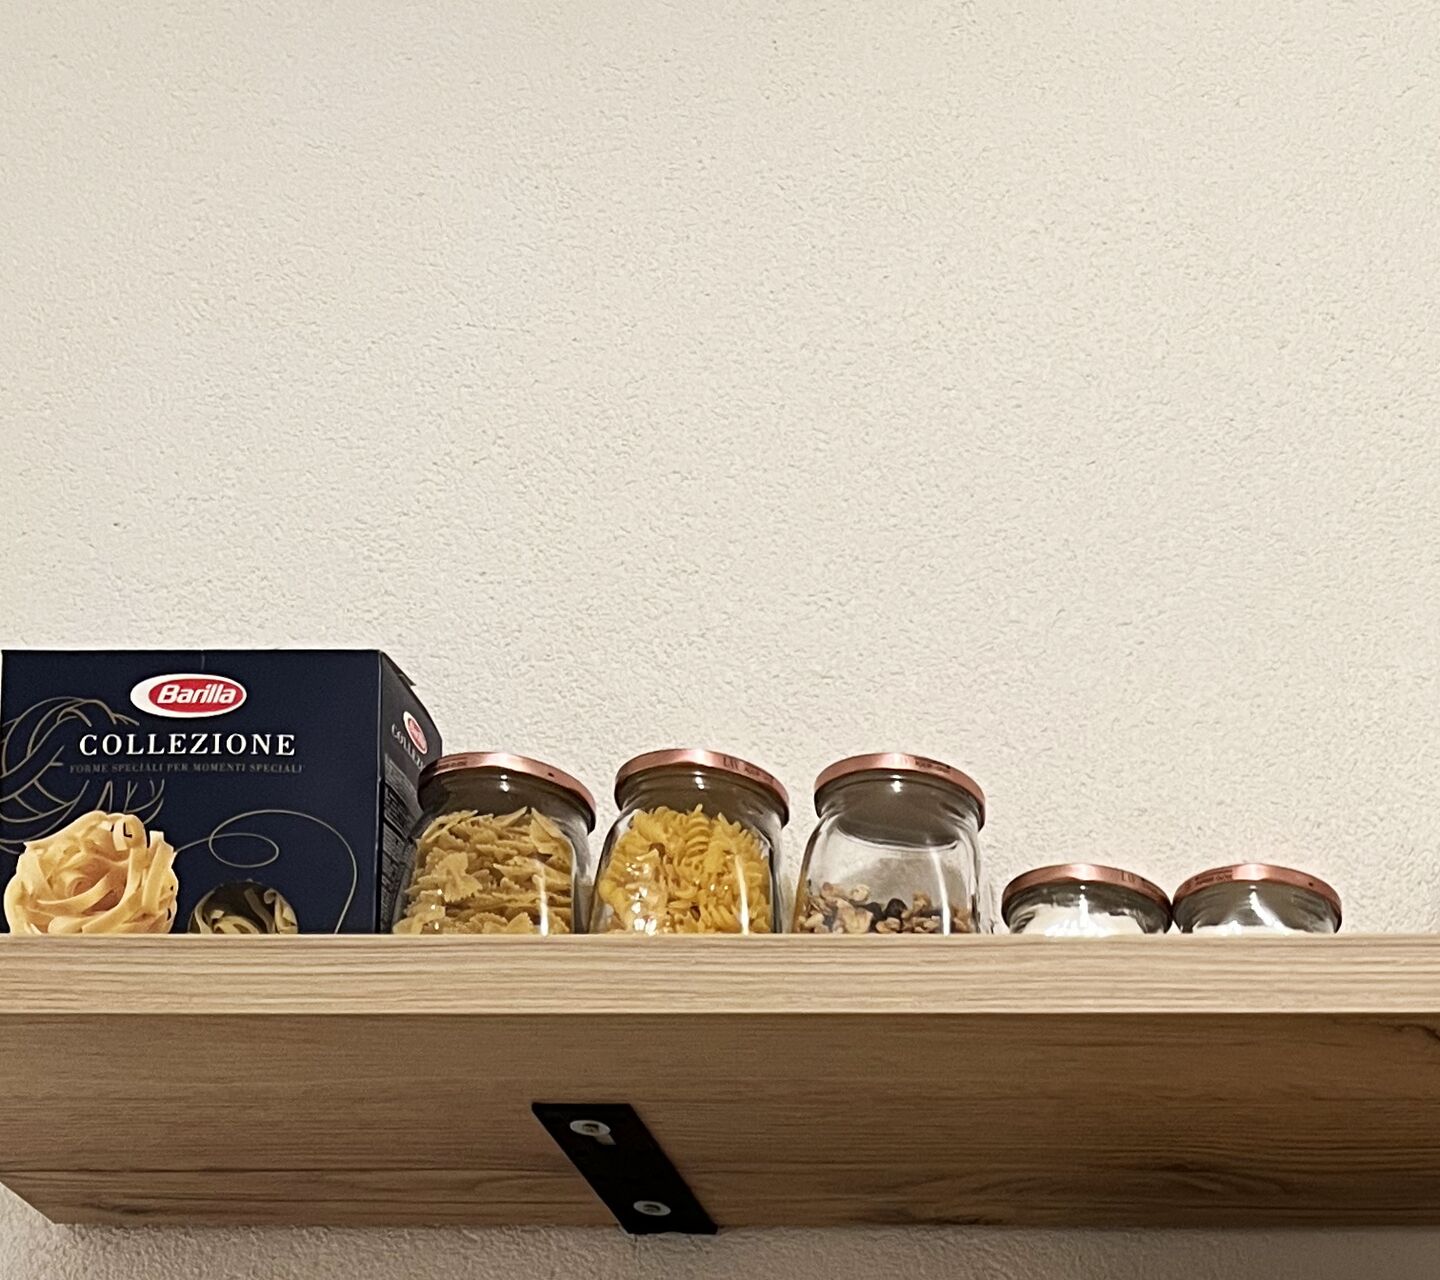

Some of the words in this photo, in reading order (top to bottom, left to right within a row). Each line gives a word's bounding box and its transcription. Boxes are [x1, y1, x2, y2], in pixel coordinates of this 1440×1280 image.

[157, 684, 236, 705] Barilla
[79, 733, 295, 756] COLLEZIONE
[167, 763, 188, 772] PER
[193, 763, 245, 772] MOMENTI
